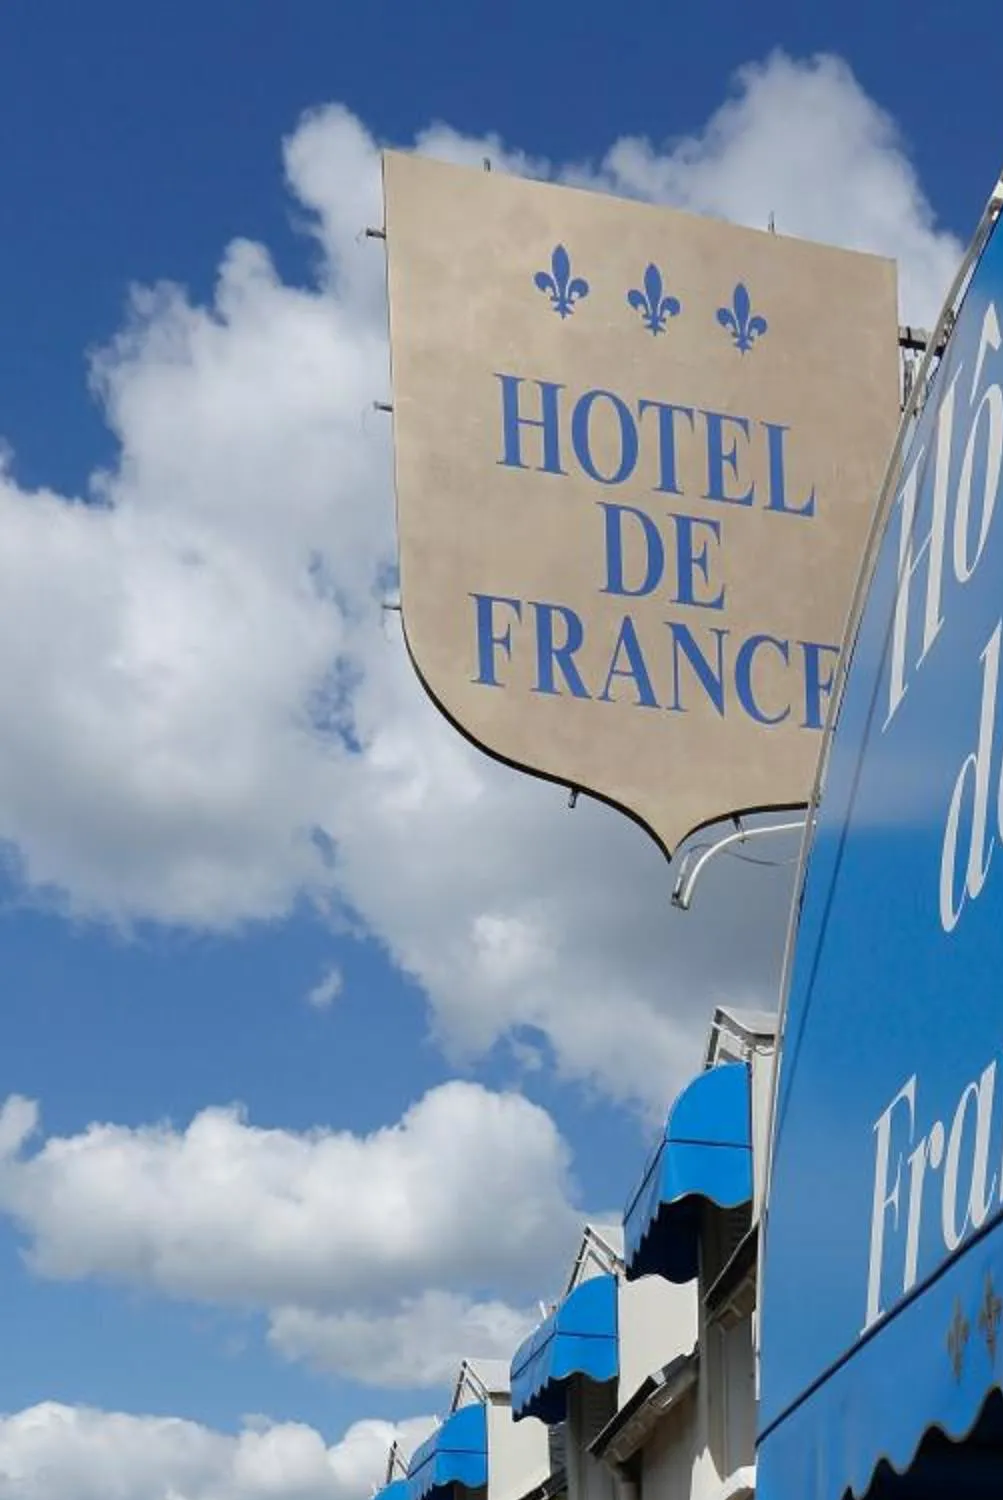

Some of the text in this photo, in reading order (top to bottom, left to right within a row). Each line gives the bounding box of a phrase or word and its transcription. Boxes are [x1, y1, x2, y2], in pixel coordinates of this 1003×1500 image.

[492, 373, 816, 518] HOTEL
[596, 501, 726, 610] DE
[467, 592, 842, 731] FRANCE
